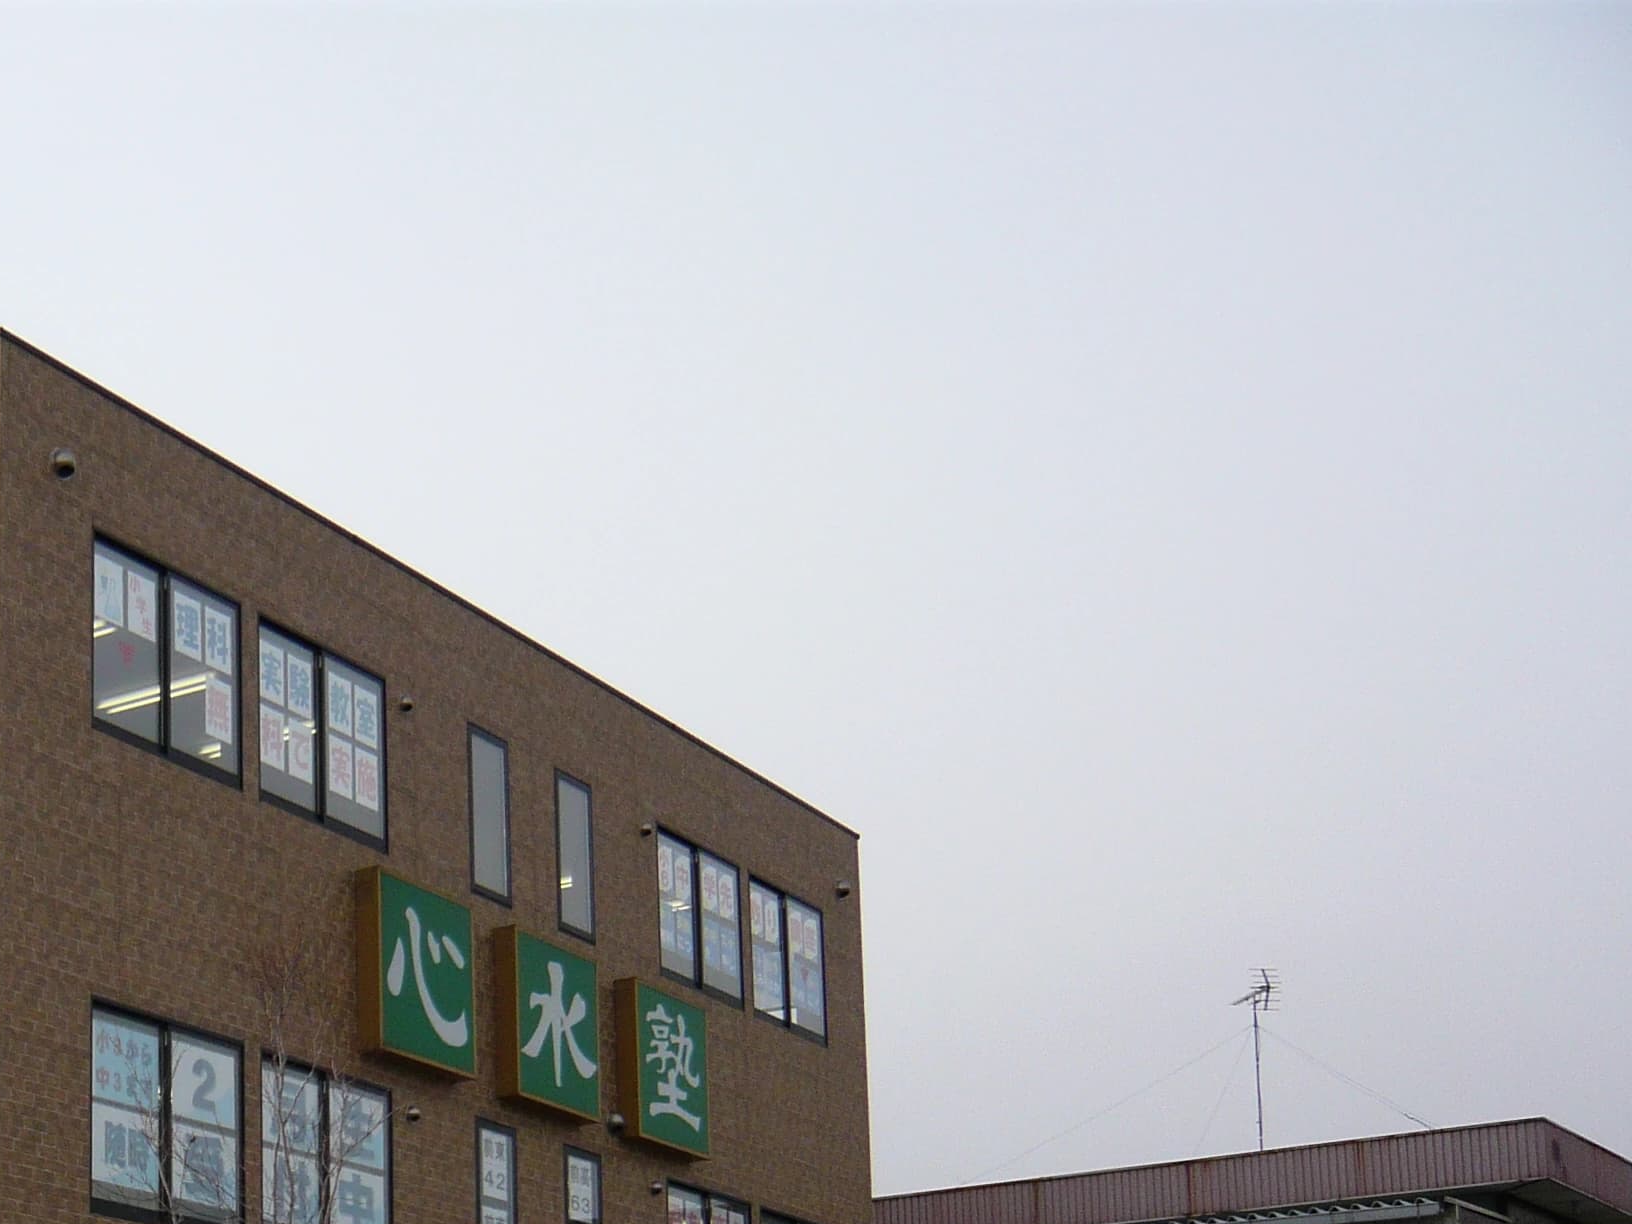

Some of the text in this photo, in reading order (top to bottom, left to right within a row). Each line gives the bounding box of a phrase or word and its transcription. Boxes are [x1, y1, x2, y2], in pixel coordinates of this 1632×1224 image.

[387, 907, 701, 1132] 心水塾
[484, 1168, 506, 1191] 42
[571, 1195, 590, 1214] 63
